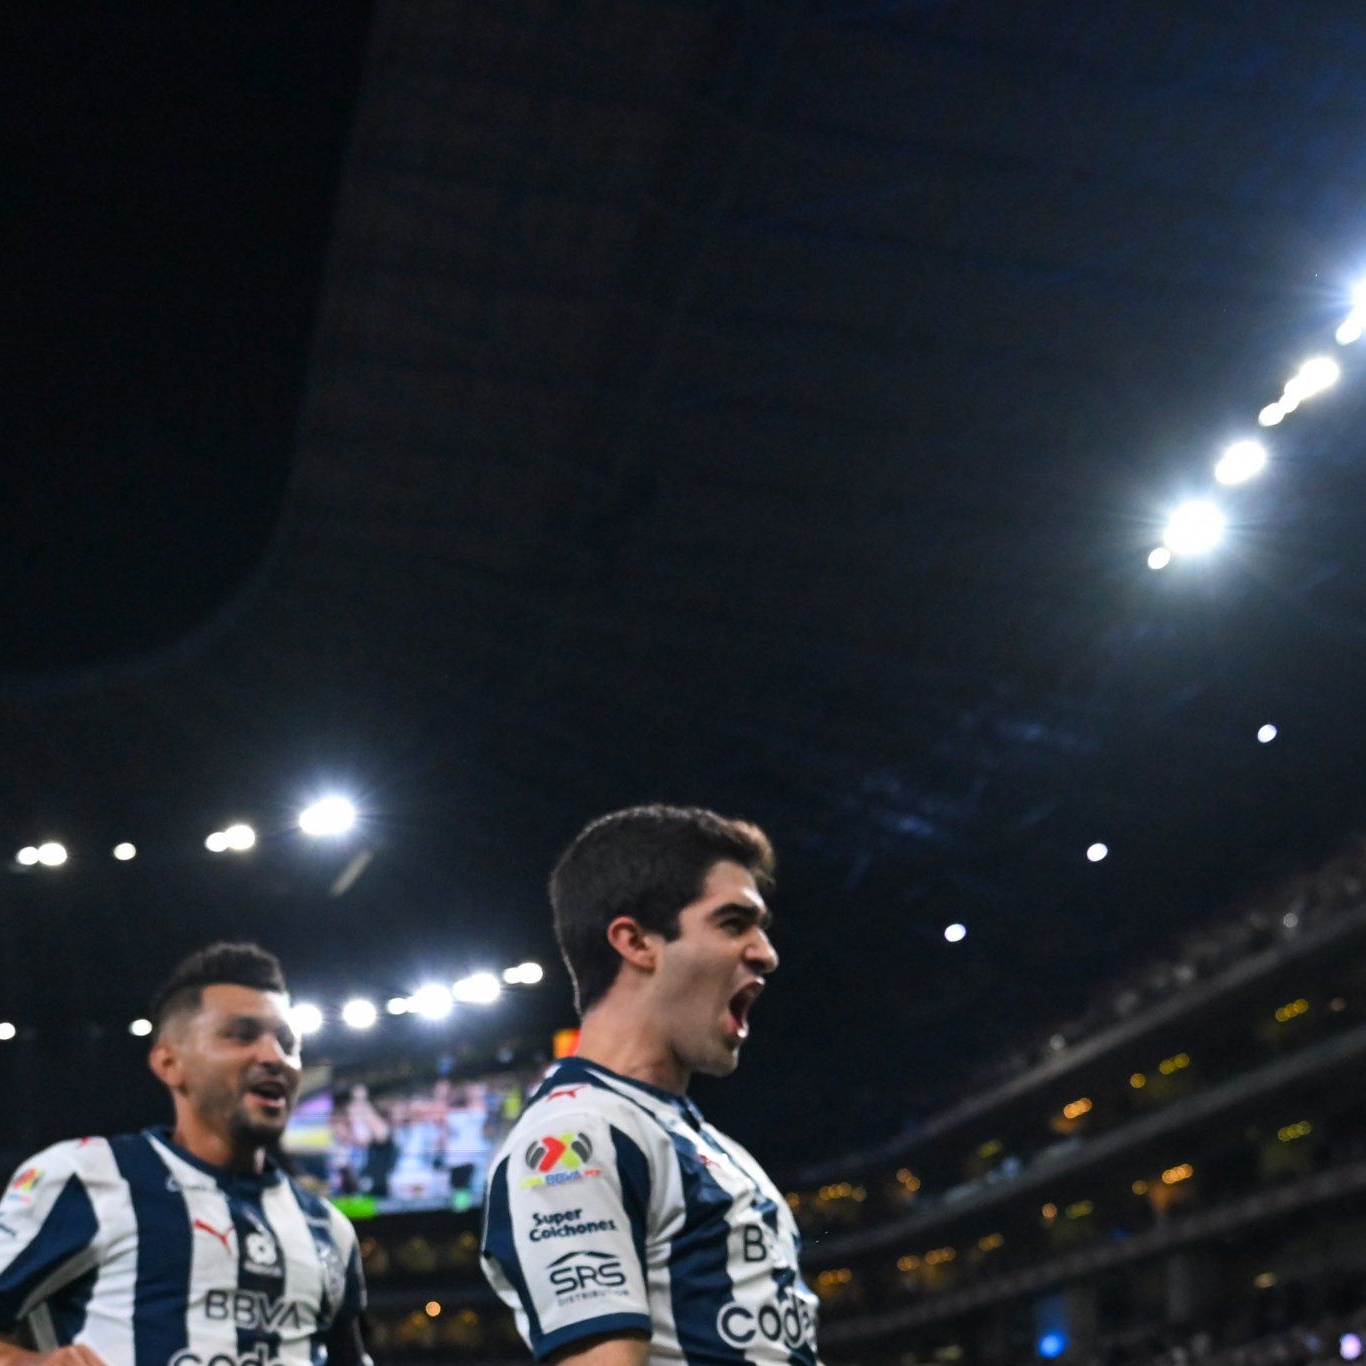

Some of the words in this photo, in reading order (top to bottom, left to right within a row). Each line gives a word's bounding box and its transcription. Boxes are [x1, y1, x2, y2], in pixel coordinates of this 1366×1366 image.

[529, 1219, 617, 1242] Colchones
[532, 1208, 582, 1226] Super
[549, 1261, 627, 1296] SRS
[204, 1288, 302, 1332] BBVA
